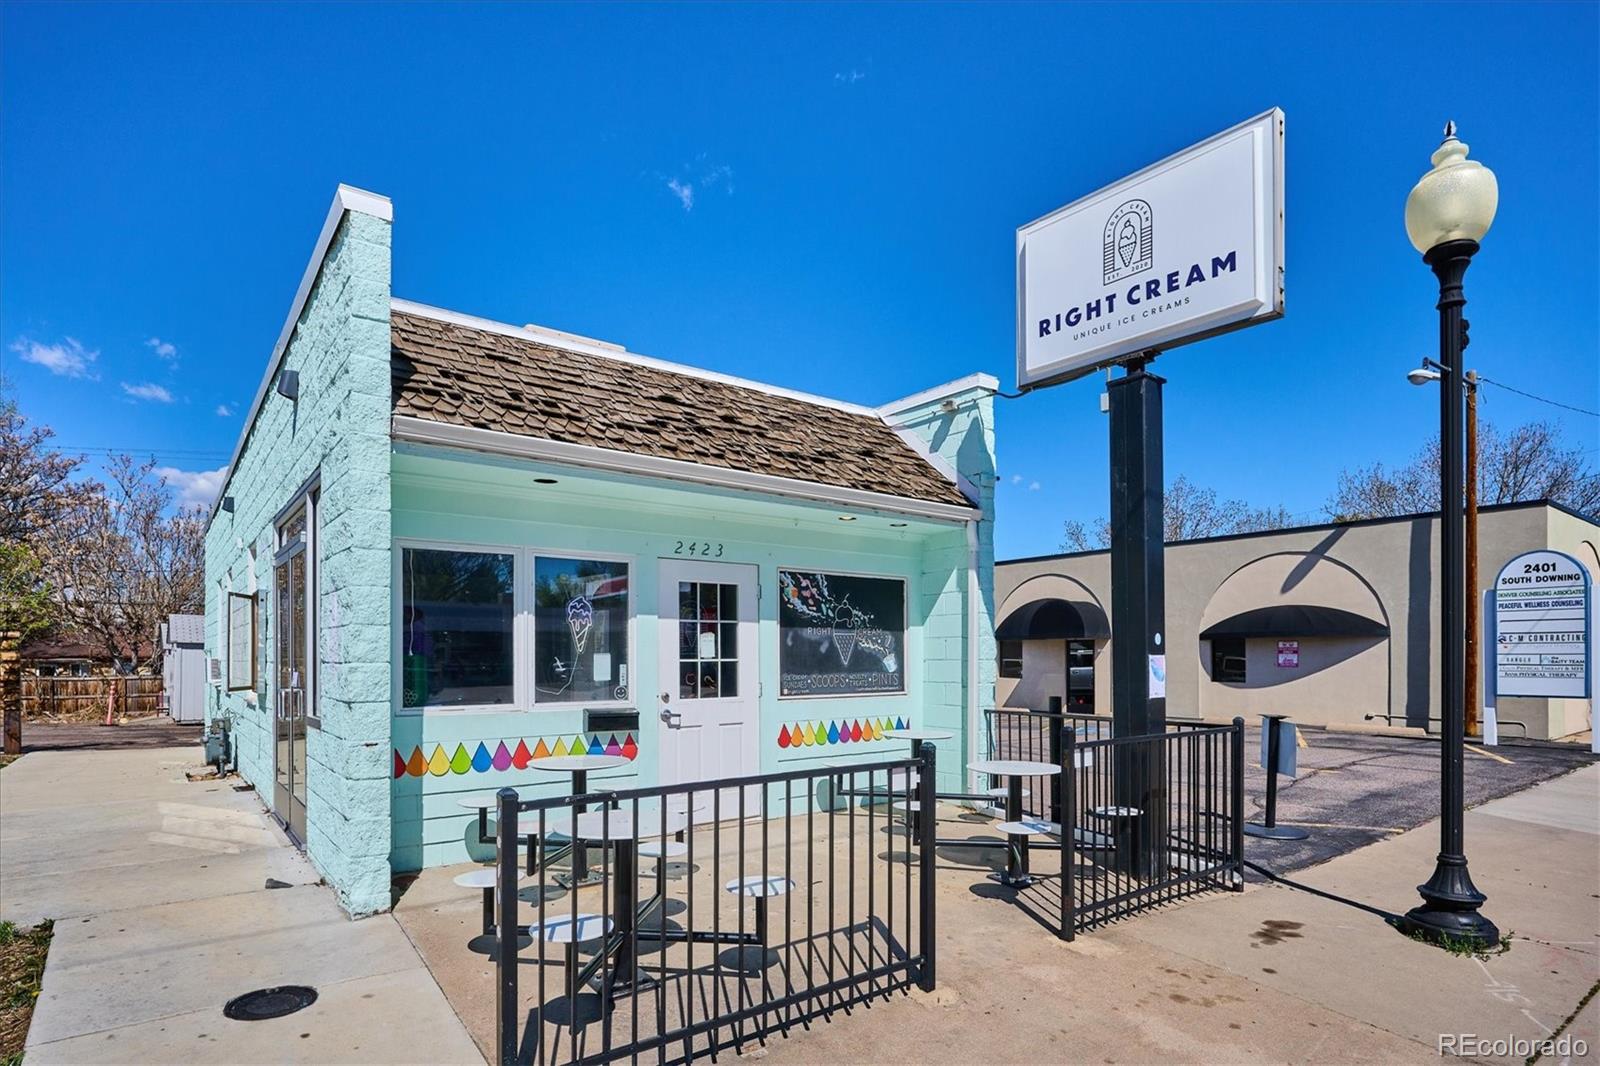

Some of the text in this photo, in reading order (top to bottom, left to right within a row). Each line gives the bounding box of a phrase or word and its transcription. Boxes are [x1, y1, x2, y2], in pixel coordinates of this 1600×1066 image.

[1131, 261, 1149, 272] 2020
[1039, 251, 1237, 338] RIGHT CREAM
[1073, 296, 1191, 341] UNIQUE ICE CREAMS
[674, 540, 724, 557] 2423
[1524, 562, 1556, 573] 2401
[1501, 573, 1581, 585] SOUTH DOWNING
[1498, 599, 1583, 610] PEACEFUL WELLNESS COUNSELING
[807, 626, 882, 636] RIGHT CREAM
[811, 674, 846, 689] SCOOPS
[872, 673, 899, 687] PINTS
